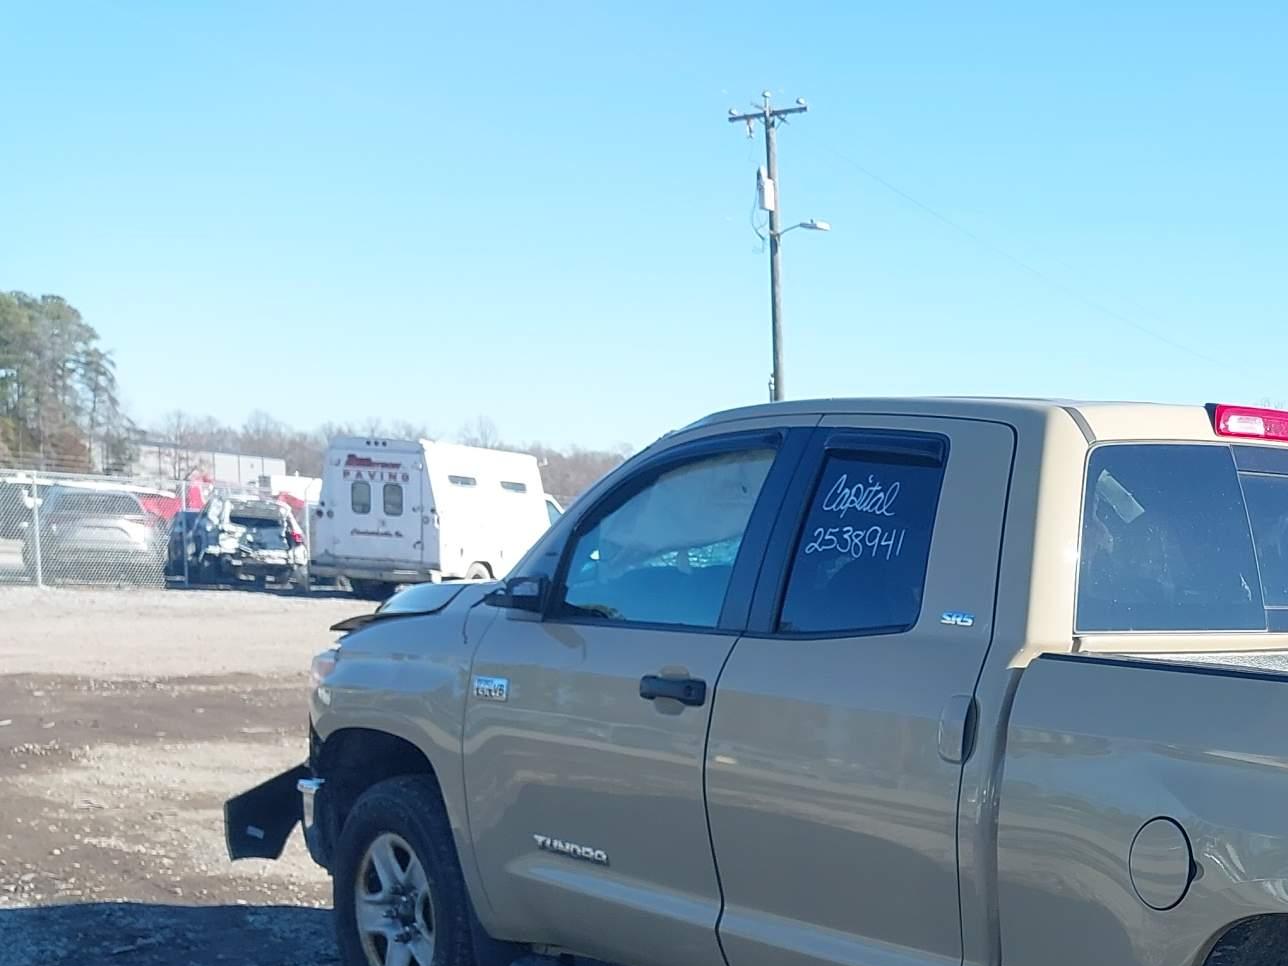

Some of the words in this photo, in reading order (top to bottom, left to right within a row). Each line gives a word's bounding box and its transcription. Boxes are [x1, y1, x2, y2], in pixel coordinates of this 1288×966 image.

[343, 470, 409, 482] PAVING
[822, 474, 900, 518] Capital
[805, 526, 905, 560] 2538941
[940, 612, 975, 626] SR5
